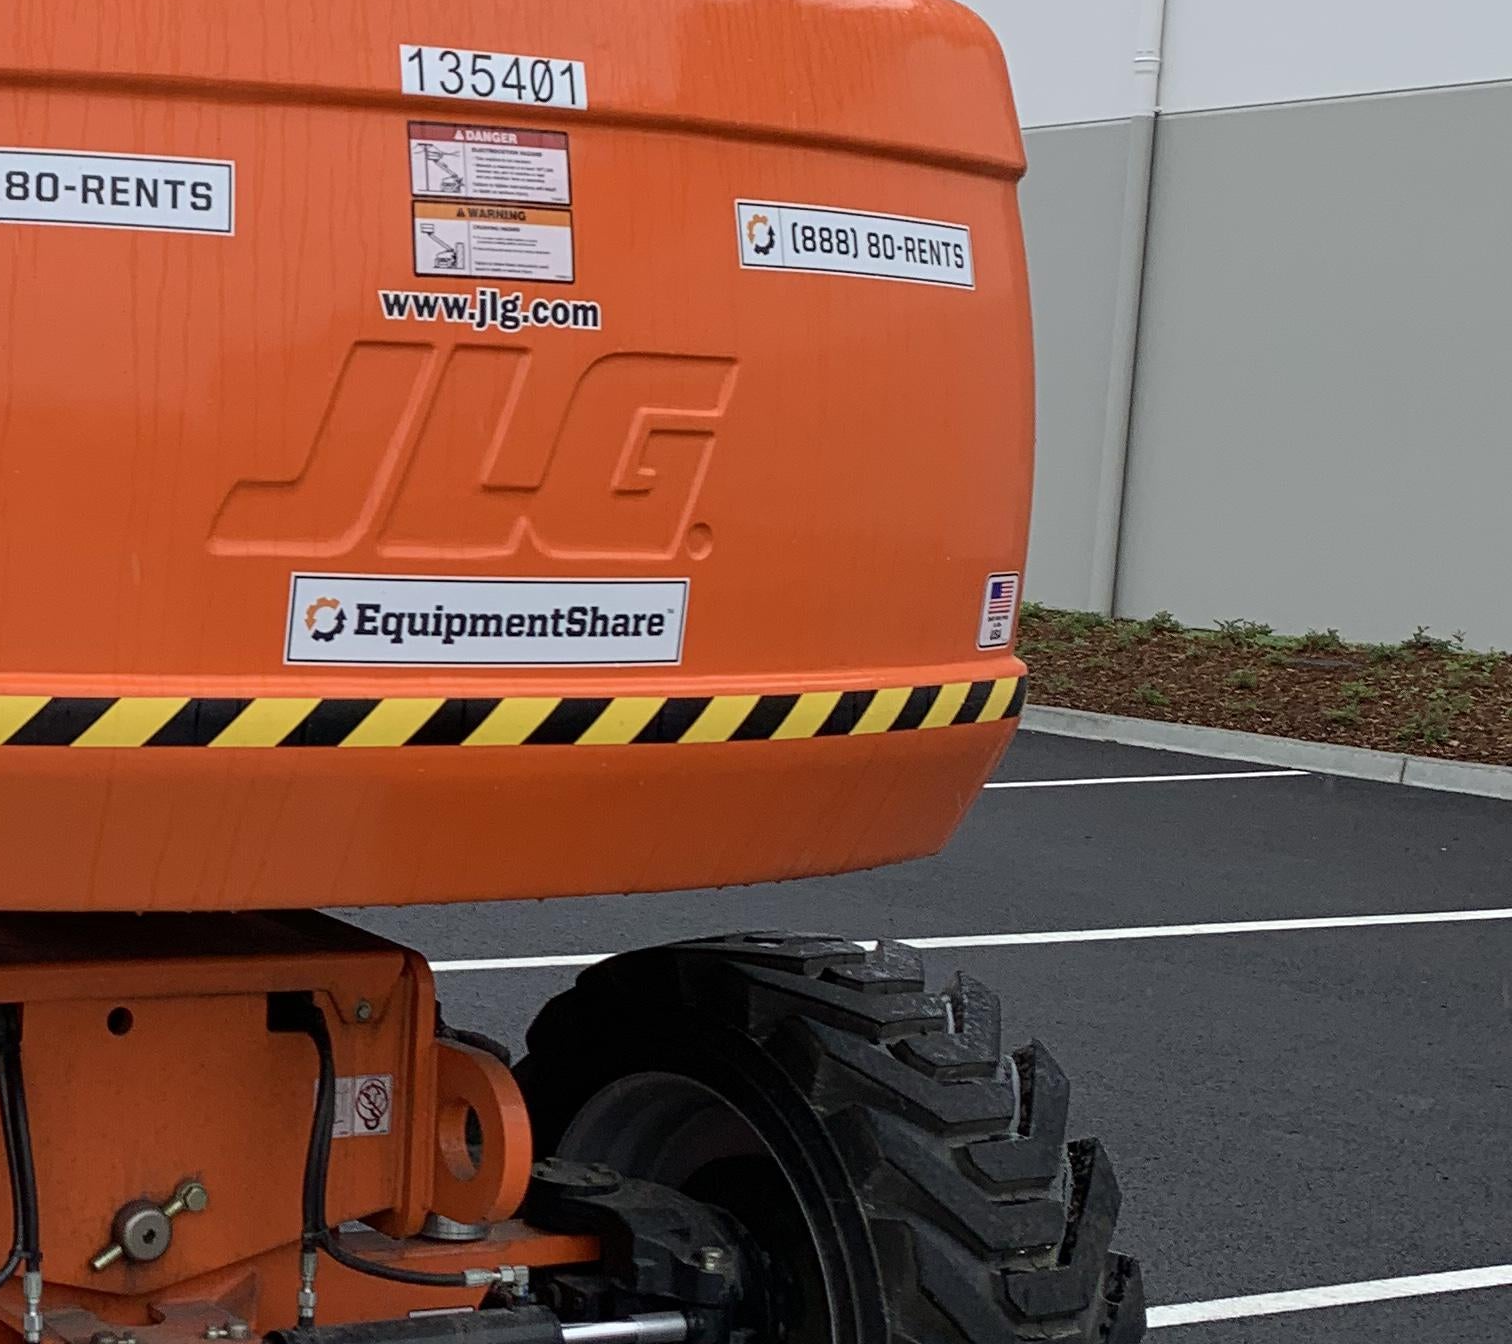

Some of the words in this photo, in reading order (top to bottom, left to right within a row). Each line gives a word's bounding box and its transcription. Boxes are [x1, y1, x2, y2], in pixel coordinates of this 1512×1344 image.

[407, 47, 577, 105] 135401
[465, 129, 518, 145] DANGER
[4, 171, 213, 212] 80-RENTS
[468, 208, 526, 221] WARNING
[791, 221, 858, 259] (888)
[867, 232, 964, 269] 80-RENTS
[381, 290, 600, 330] www.jlg.com
[354, 602, 665, 645] EquipmentShare
